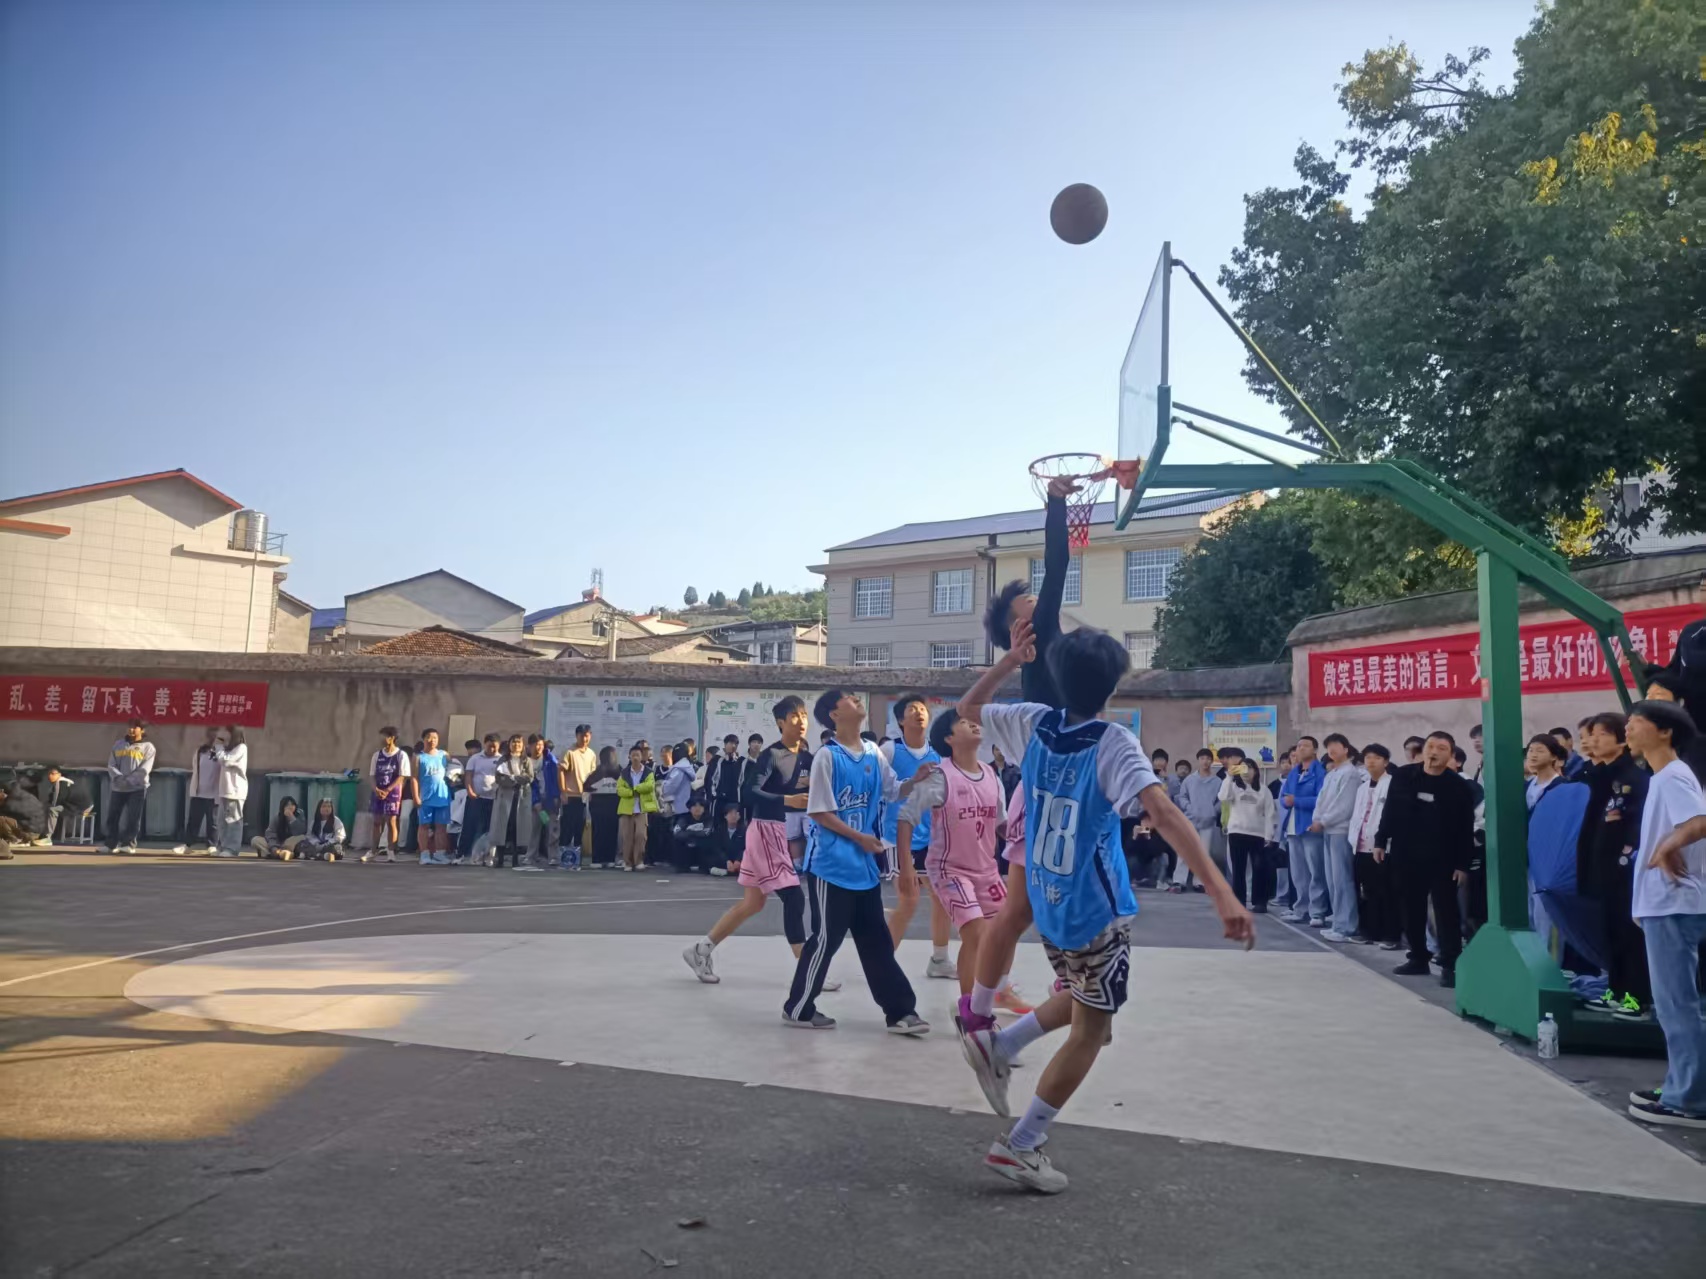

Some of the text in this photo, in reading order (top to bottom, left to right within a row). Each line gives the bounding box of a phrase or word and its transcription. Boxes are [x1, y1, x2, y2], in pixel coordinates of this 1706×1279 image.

[1323, 626, 1658, 696] 微笑是最美的语言,文最好的象!
